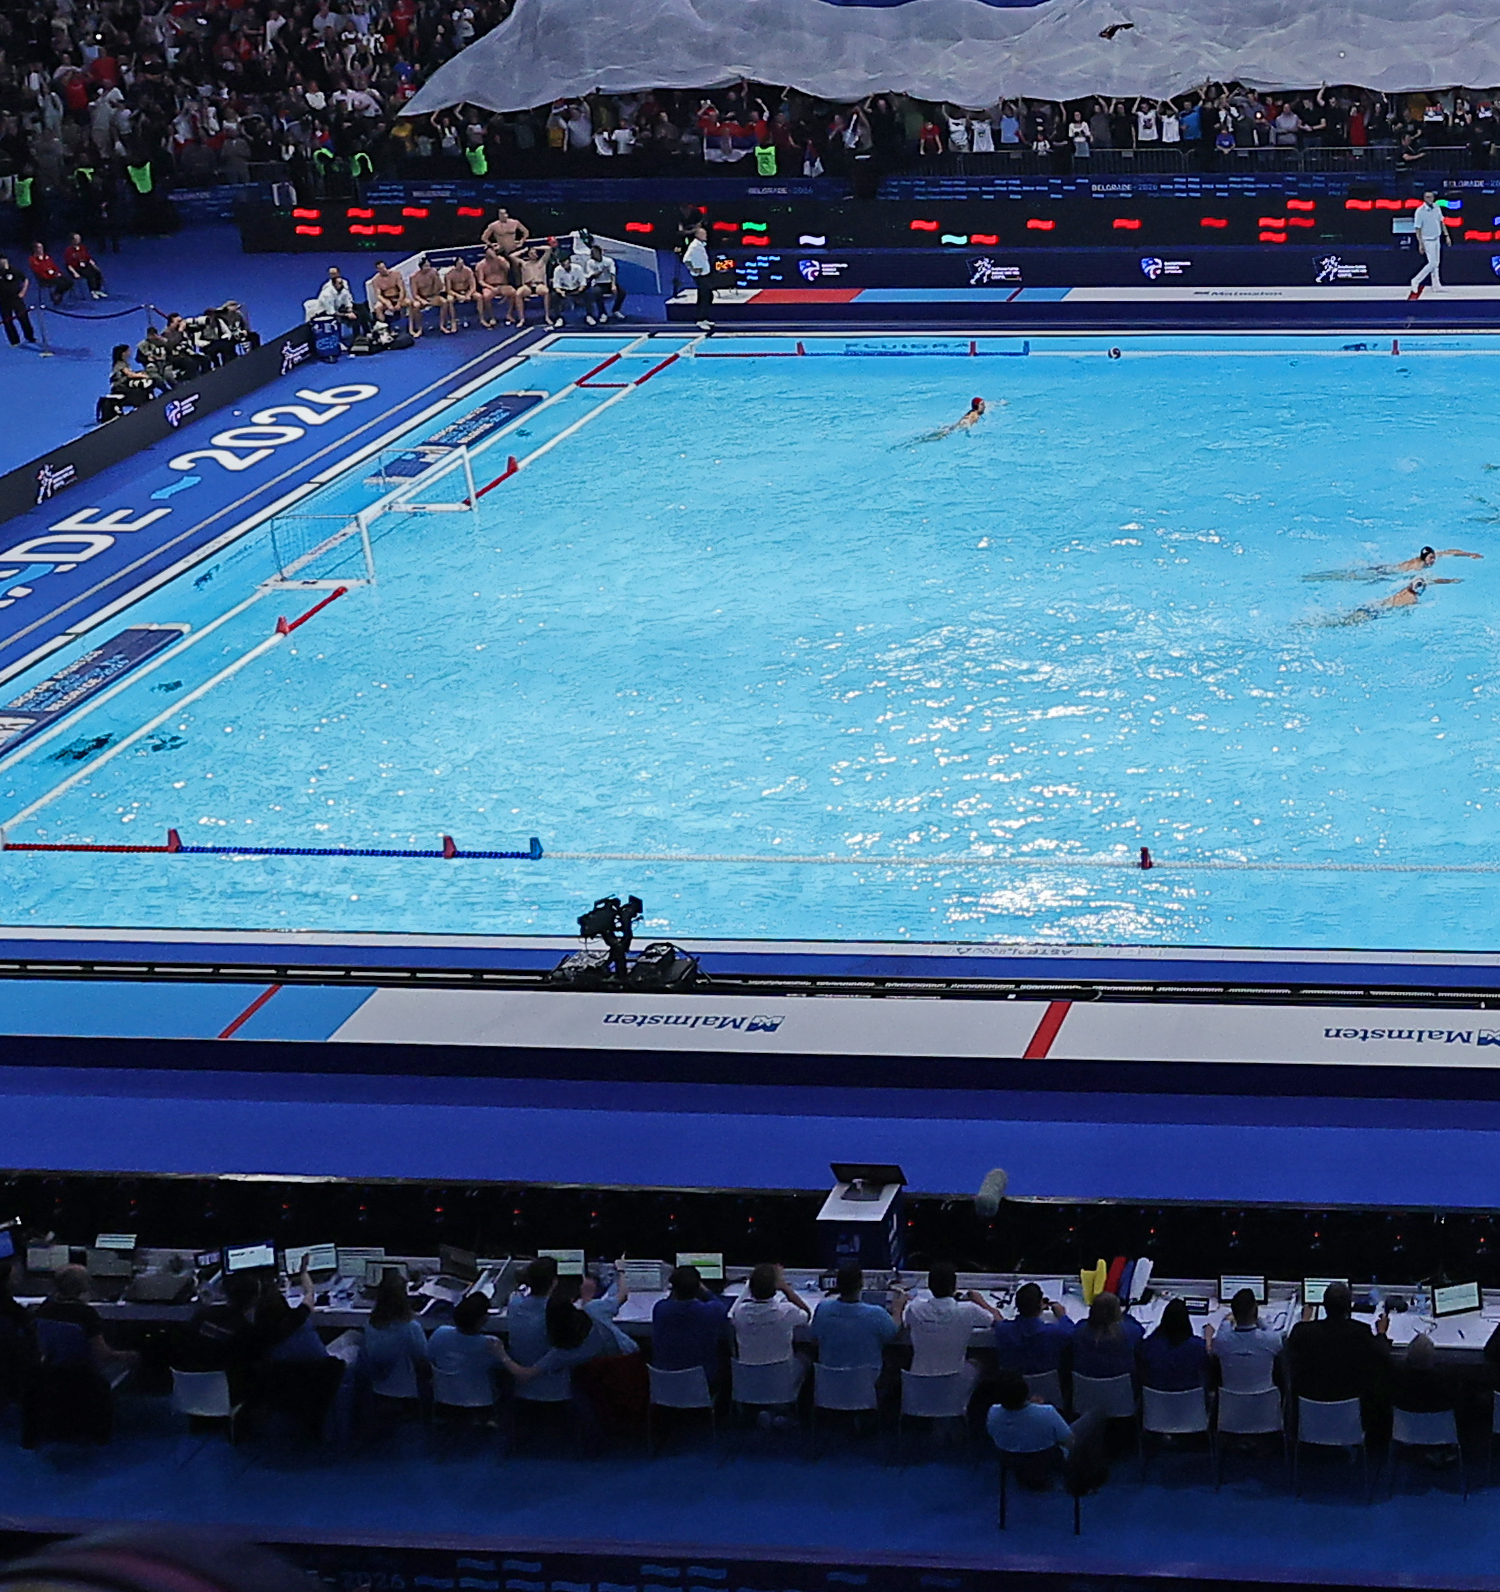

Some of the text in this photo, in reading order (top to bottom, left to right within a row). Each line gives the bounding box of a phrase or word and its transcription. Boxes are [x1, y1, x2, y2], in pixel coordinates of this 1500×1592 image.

[168, 381, 381, 475] 2026
[602, 1014, 748, 1029] Malmsten
[1323, 1027, 1474, 1044] Malmsten
